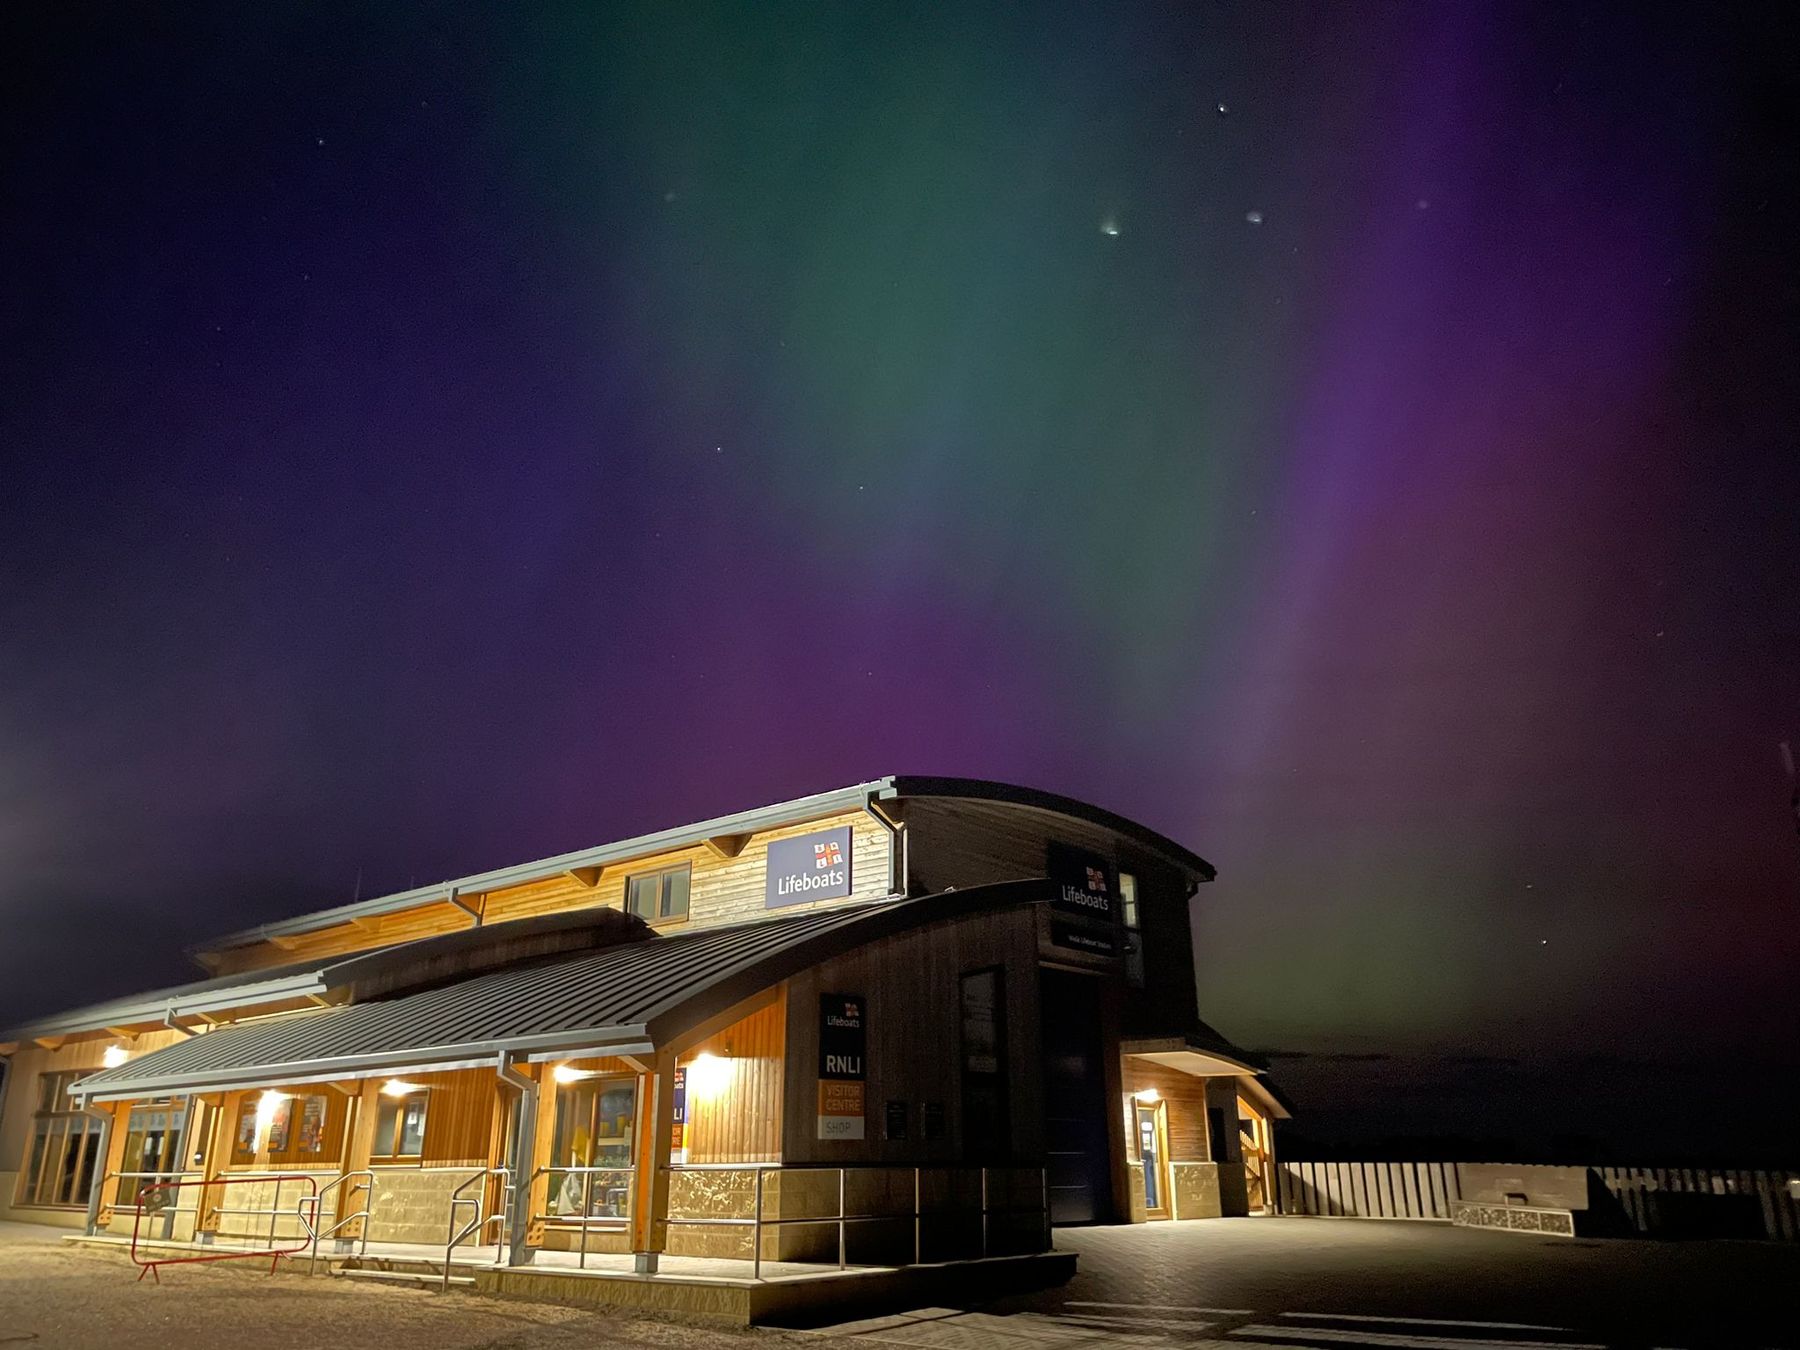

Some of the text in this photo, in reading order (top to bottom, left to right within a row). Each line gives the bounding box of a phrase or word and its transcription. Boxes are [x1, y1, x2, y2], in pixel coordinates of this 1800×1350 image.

[778, 869, 843, 895] Lifeboats
[1062, 885, 1109, 911] Lifeboats
[827, 1015, 860, 1028] Lifeboats
[826, 1055, 860, 1074] RNLI
[827, 1084, 860, 1097] VISITOR
[825, 1098, 861, 1112] CENTRE
[673, 1107, 683, 1120] LI
[826, 1121, 851, 1134] SHOP
